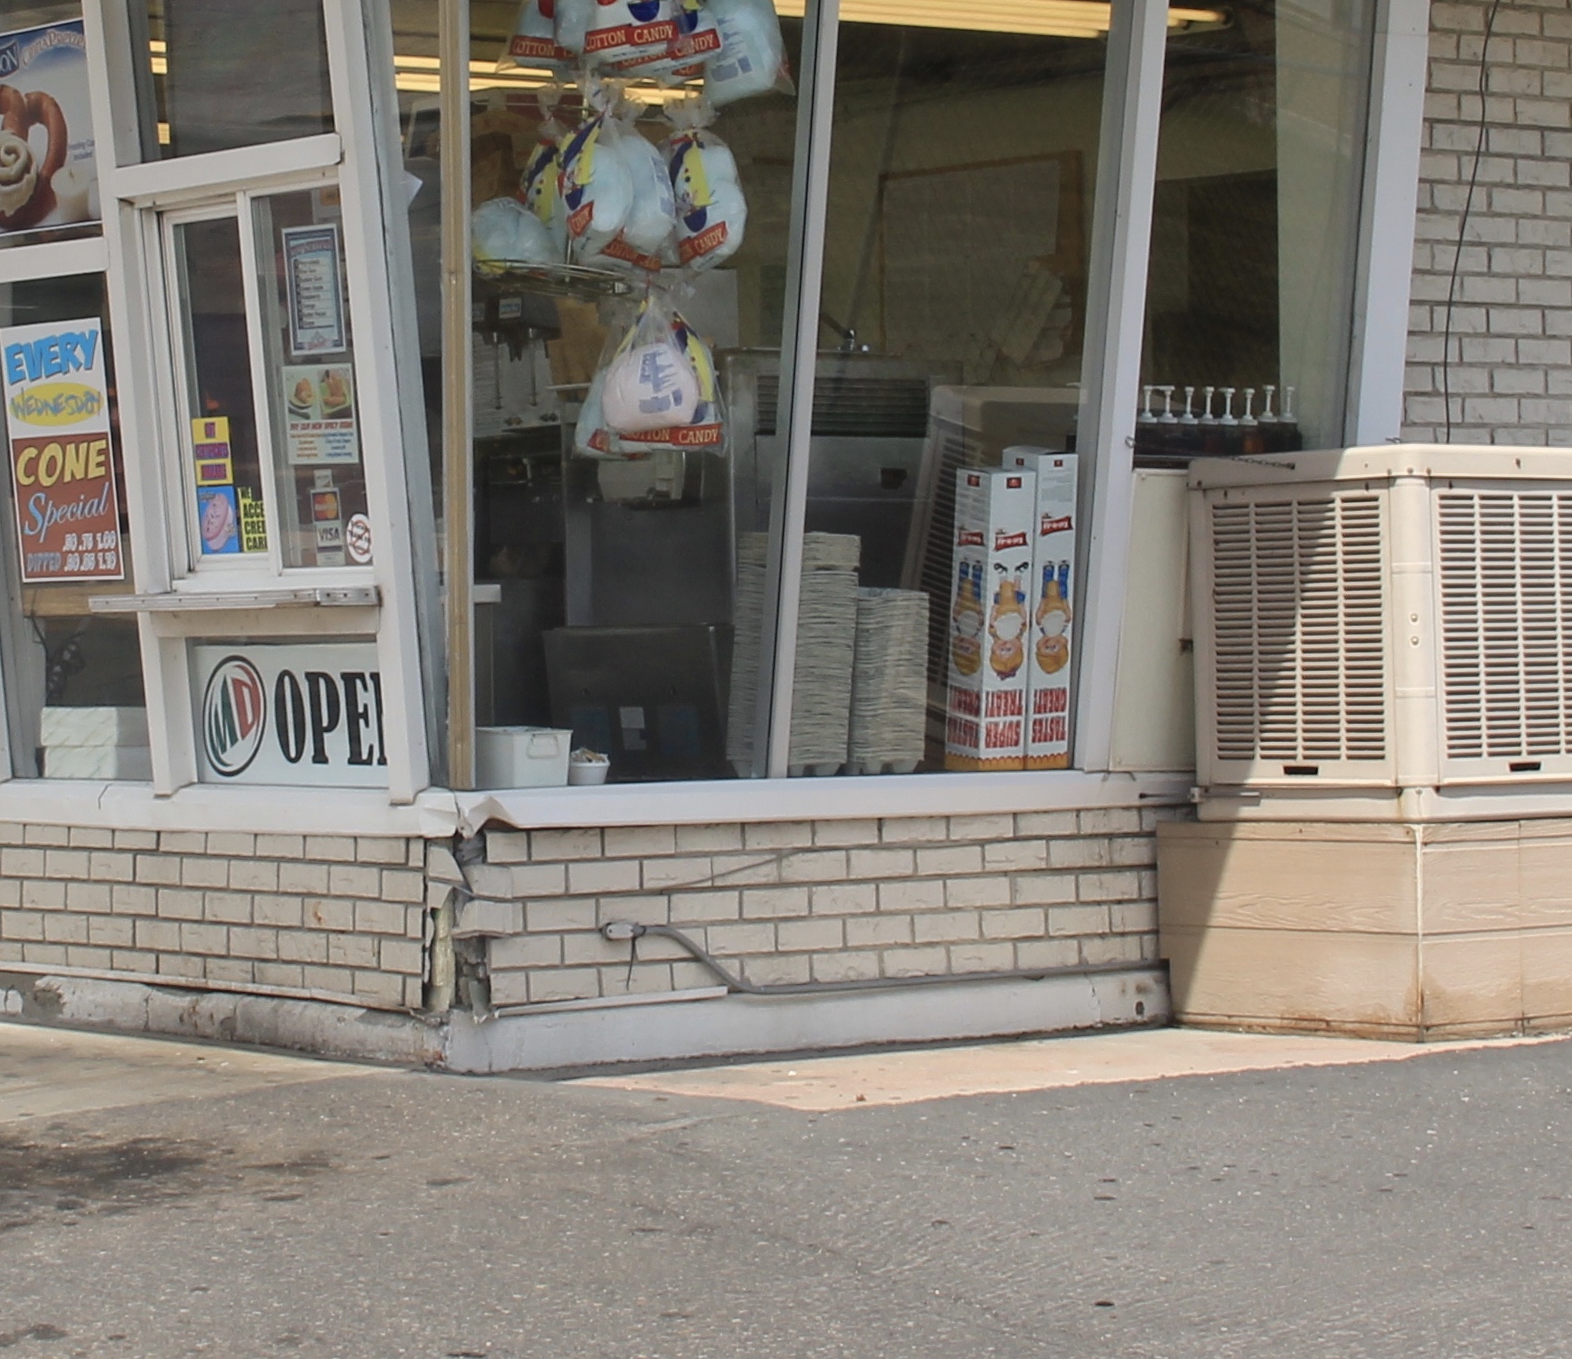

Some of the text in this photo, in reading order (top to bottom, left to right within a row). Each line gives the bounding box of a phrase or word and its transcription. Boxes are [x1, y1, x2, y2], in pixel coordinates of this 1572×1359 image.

[513, 40, 556, 56] COTTON
[586, 24, 674, 50] COTTON CANDY
[676, 34, 714, 56] CANDY
[693, 227, 724, 253] CANDY
[5, 329, 99, 386] EVERY
[679, 428, 719, 443] CANDY
[16, 439, 107, 487] CONE
[23, 481, 110, 544] Special
[96, 530, 116, 549] 1.00
[317, 527, 340, 541] VISA
[985, 689, 1023, 717] TREAT!
[985, 720, 1021, 749] SUPER
